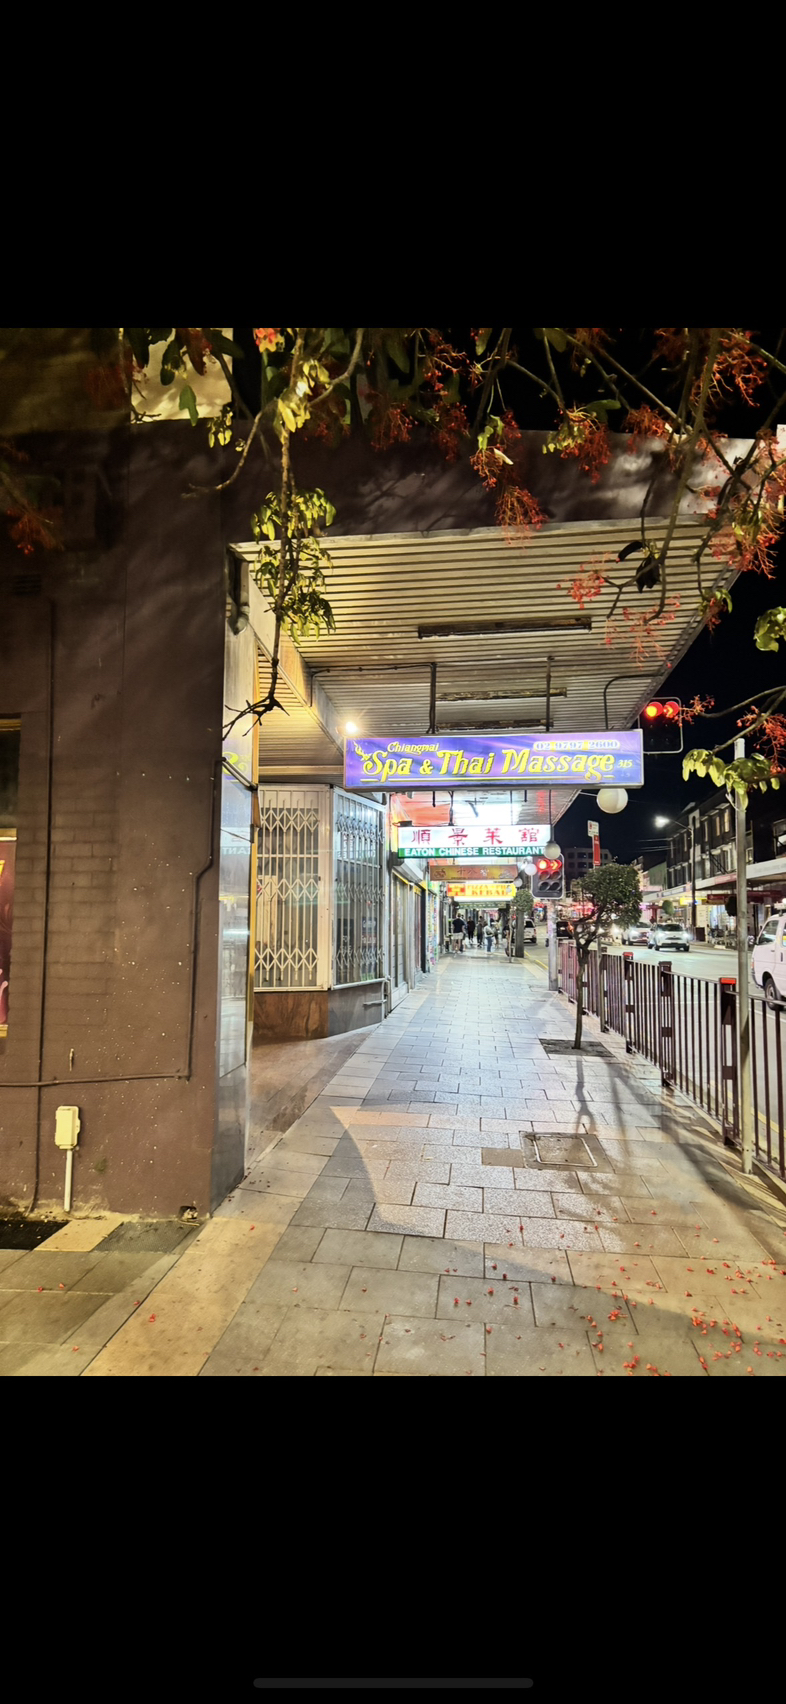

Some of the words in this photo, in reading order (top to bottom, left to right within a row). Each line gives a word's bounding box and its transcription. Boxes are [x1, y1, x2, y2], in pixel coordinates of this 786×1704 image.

[387, 741, 440, 756] Chiangmai
[536, 742, 550, 750] 02
[555, 741, 583, 749] 9797
[588, 740, 618, 748] 2600
[363, 750, 413, 783] Spa
[419, 759, 433, 775] &
[436, 750, 496, 775] Thai
[501, 748, 616, 783] Massage
[404, 848, 435, 857] EATON
[438, 847, 479, 856] CHINESE
[483, 846, 545, 856] RESTAURANT
